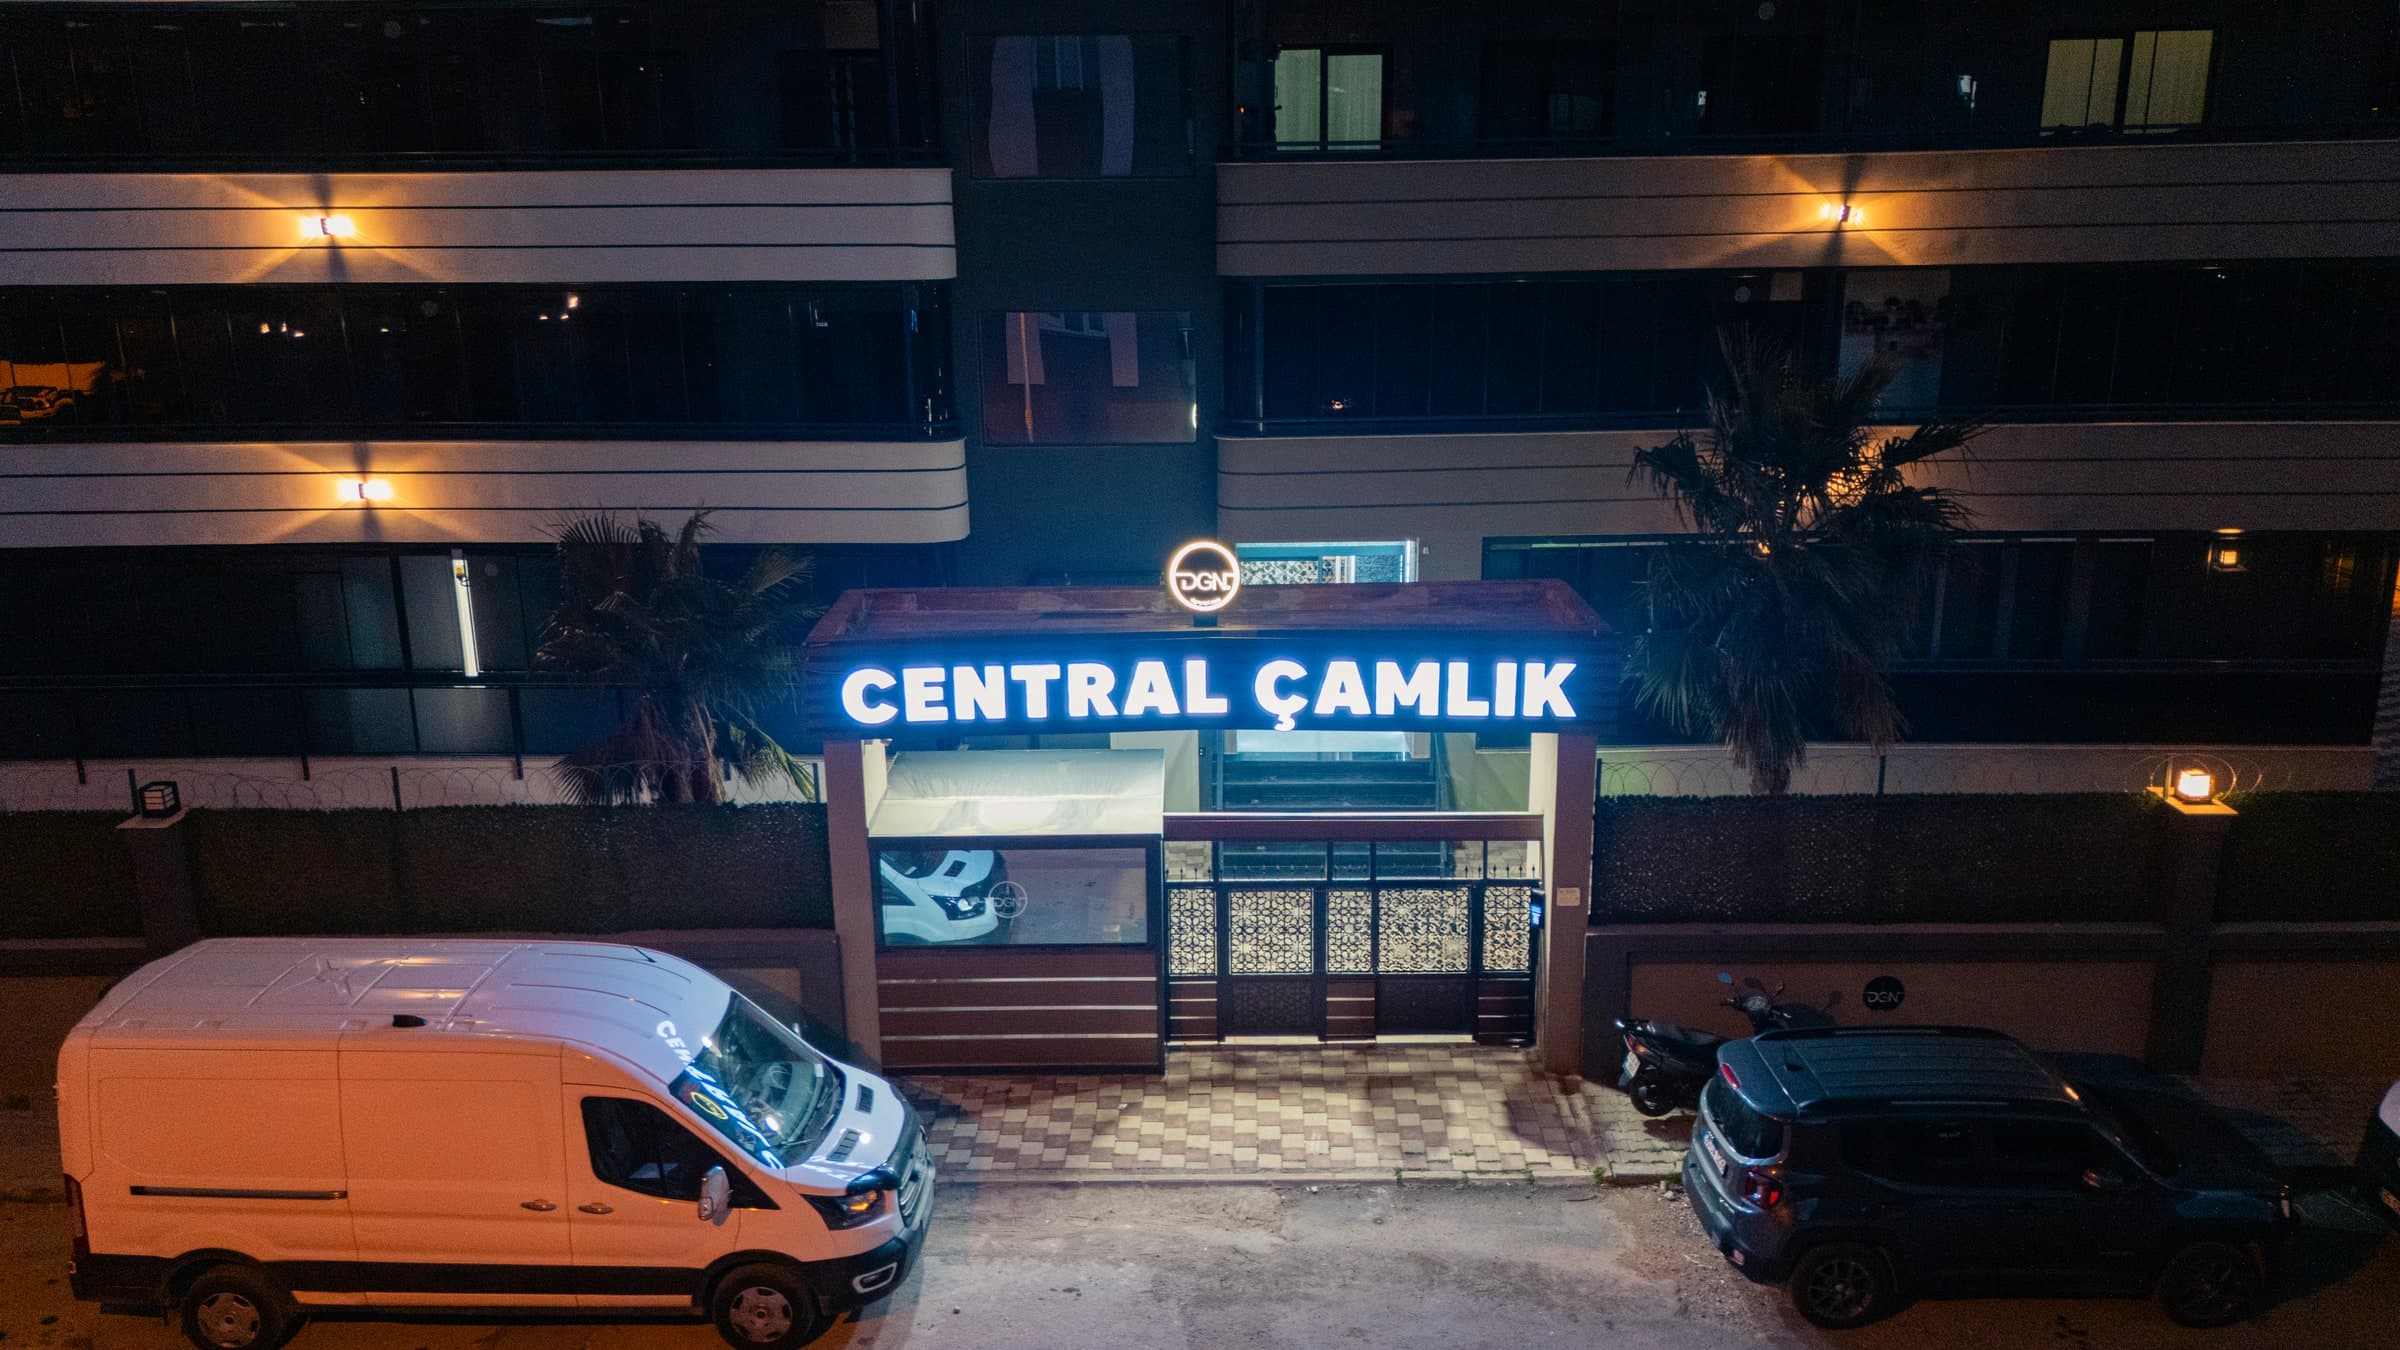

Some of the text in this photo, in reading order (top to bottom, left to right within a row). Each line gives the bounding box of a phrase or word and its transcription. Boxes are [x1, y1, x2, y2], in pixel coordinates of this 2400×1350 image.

[1178, 571, 1232, 591] DGN
[841, 660, 1578, 731] CENTRAL ÇAMLIK
